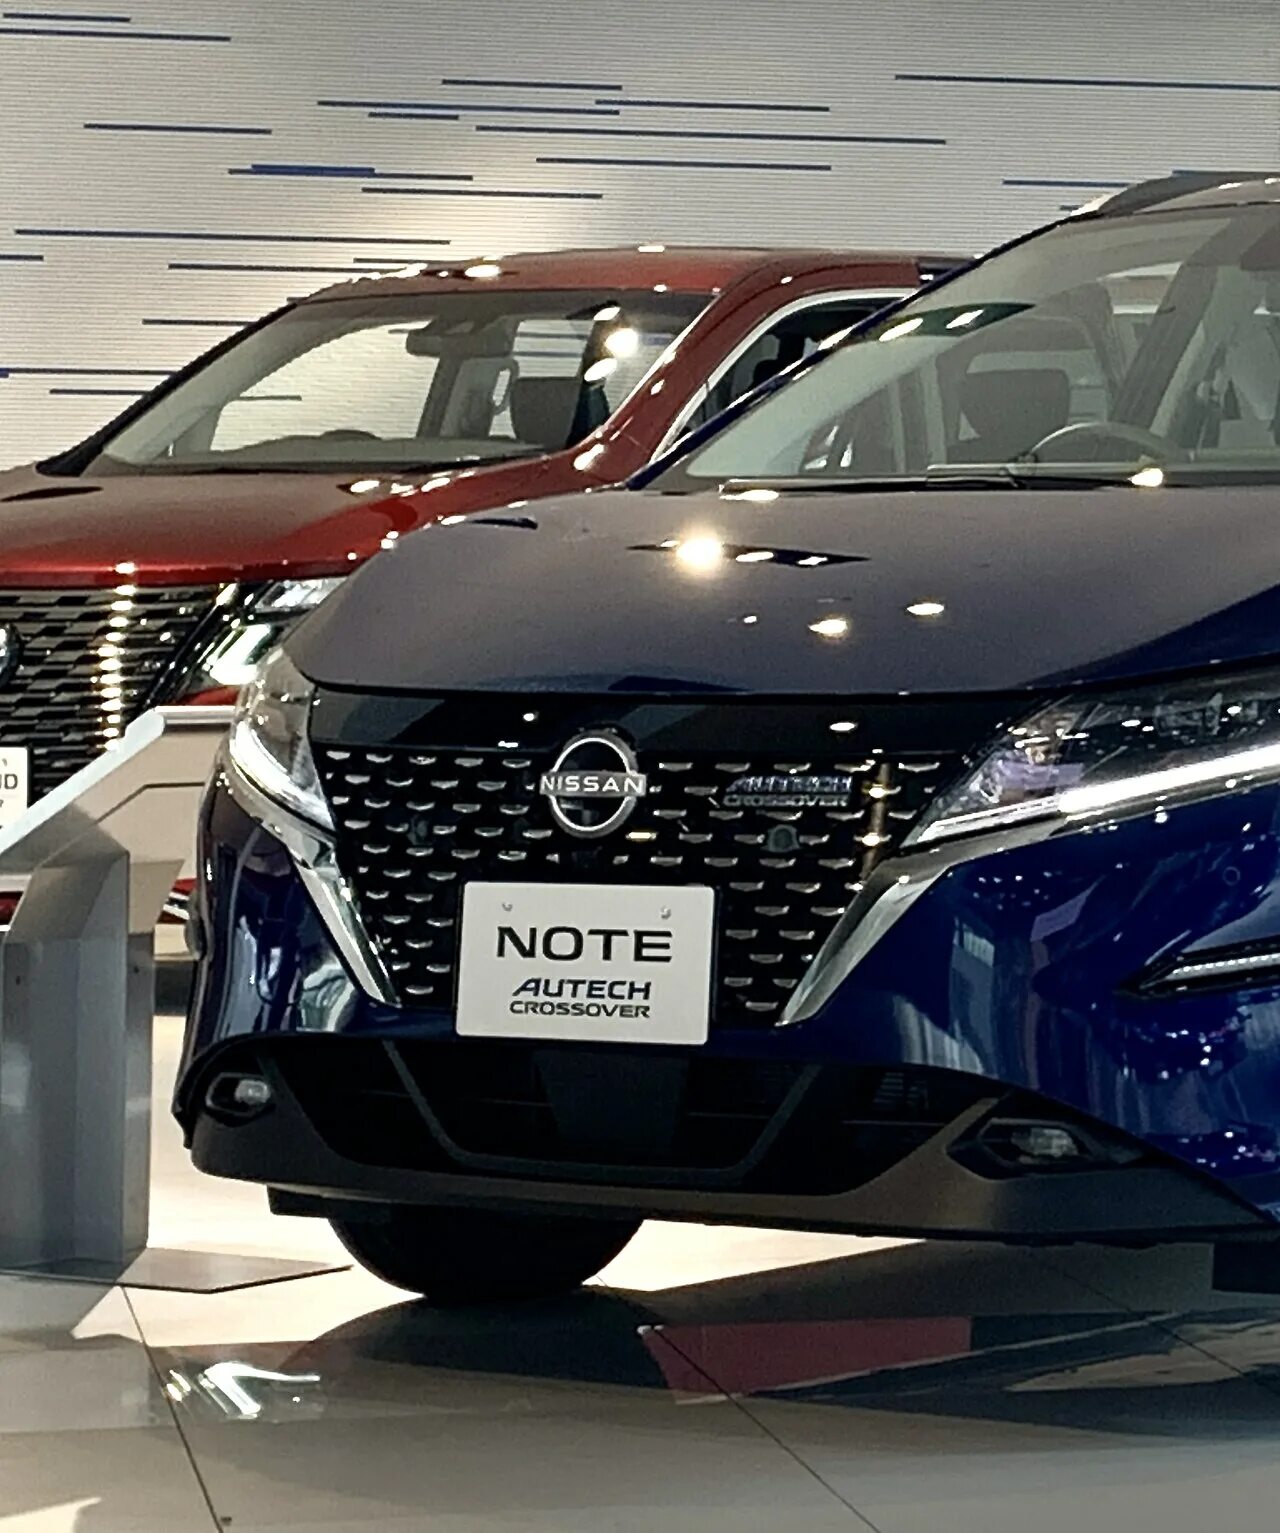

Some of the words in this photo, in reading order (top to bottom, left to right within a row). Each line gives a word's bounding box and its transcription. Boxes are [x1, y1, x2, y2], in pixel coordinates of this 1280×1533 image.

[541, 775, 643, 794] NISSAN
[496, 926, 673, 963] NOTE
[512, 977, 652, 1000] AUTECH
[509, 1001, 651, 1018] CROSSOVER
